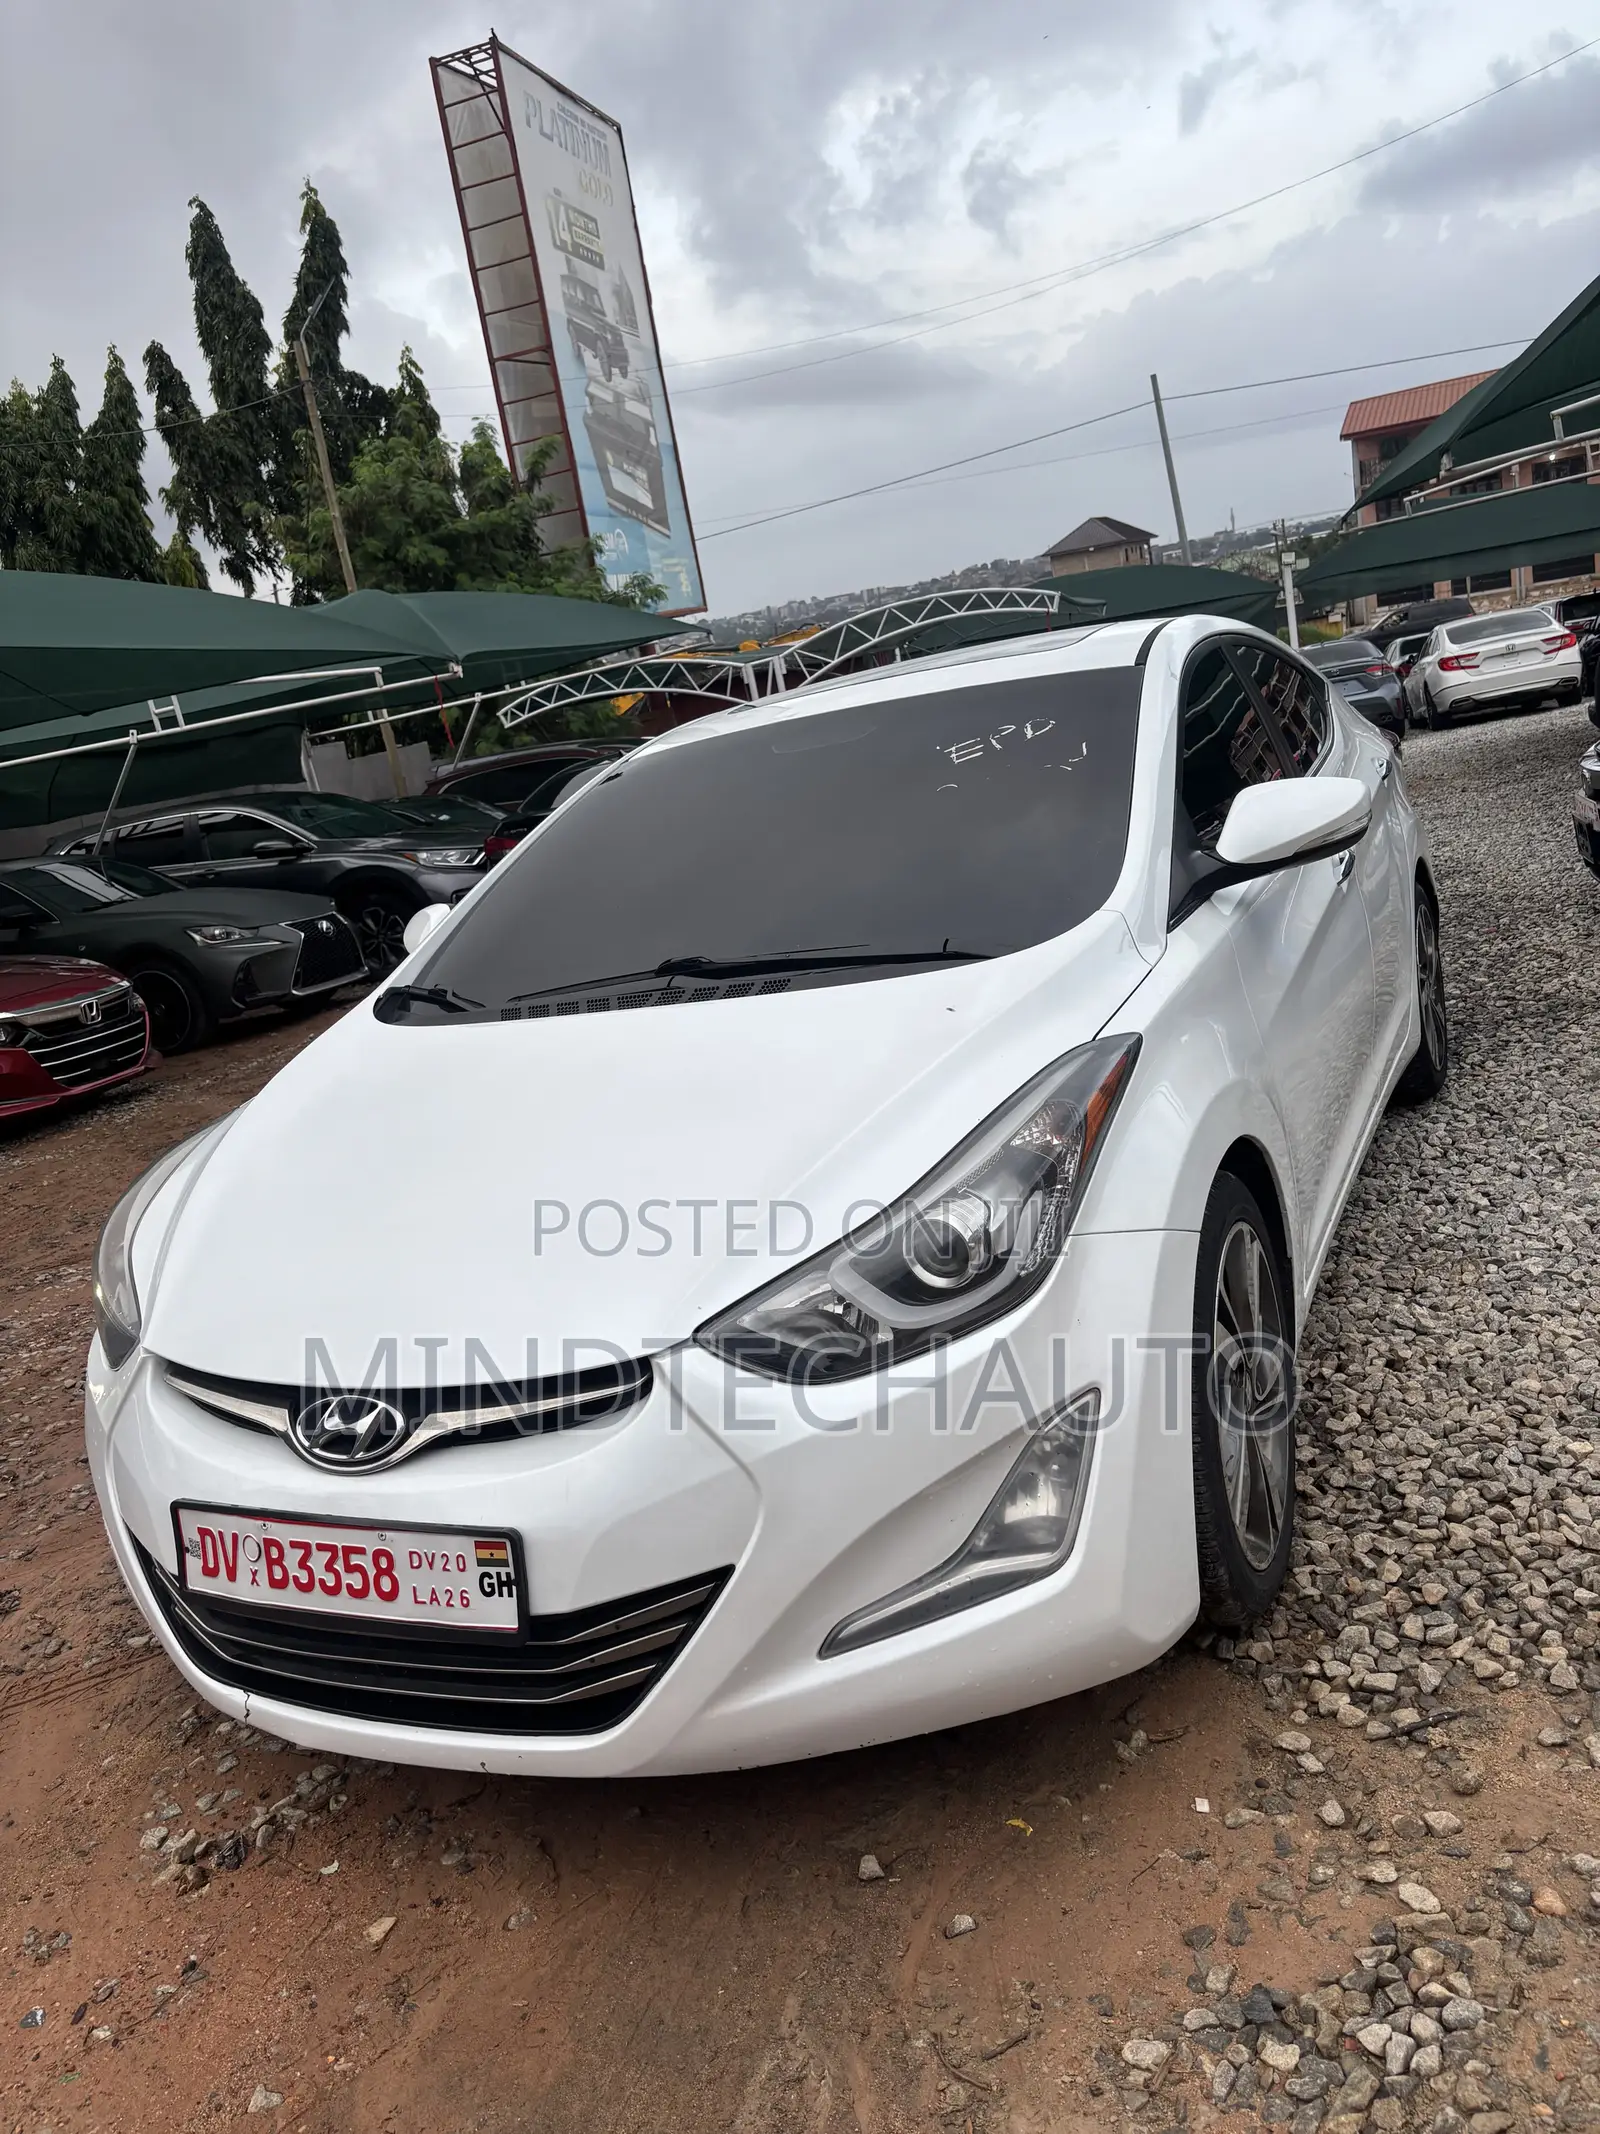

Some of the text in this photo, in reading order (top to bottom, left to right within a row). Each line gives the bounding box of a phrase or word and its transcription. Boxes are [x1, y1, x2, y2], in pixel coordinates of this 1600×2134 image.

[523, 91, 612, 178] PLATINUM
[579, 168, 614, 207] GOLD
[545, 197, 573, 252] 14
[196, 1525, 401, 1602] DV B3358
[408, 1549, 468, 1573] DV20
[412, 1584, 471, 1609] LA26
[478, 1570, 515, 1599] GH
